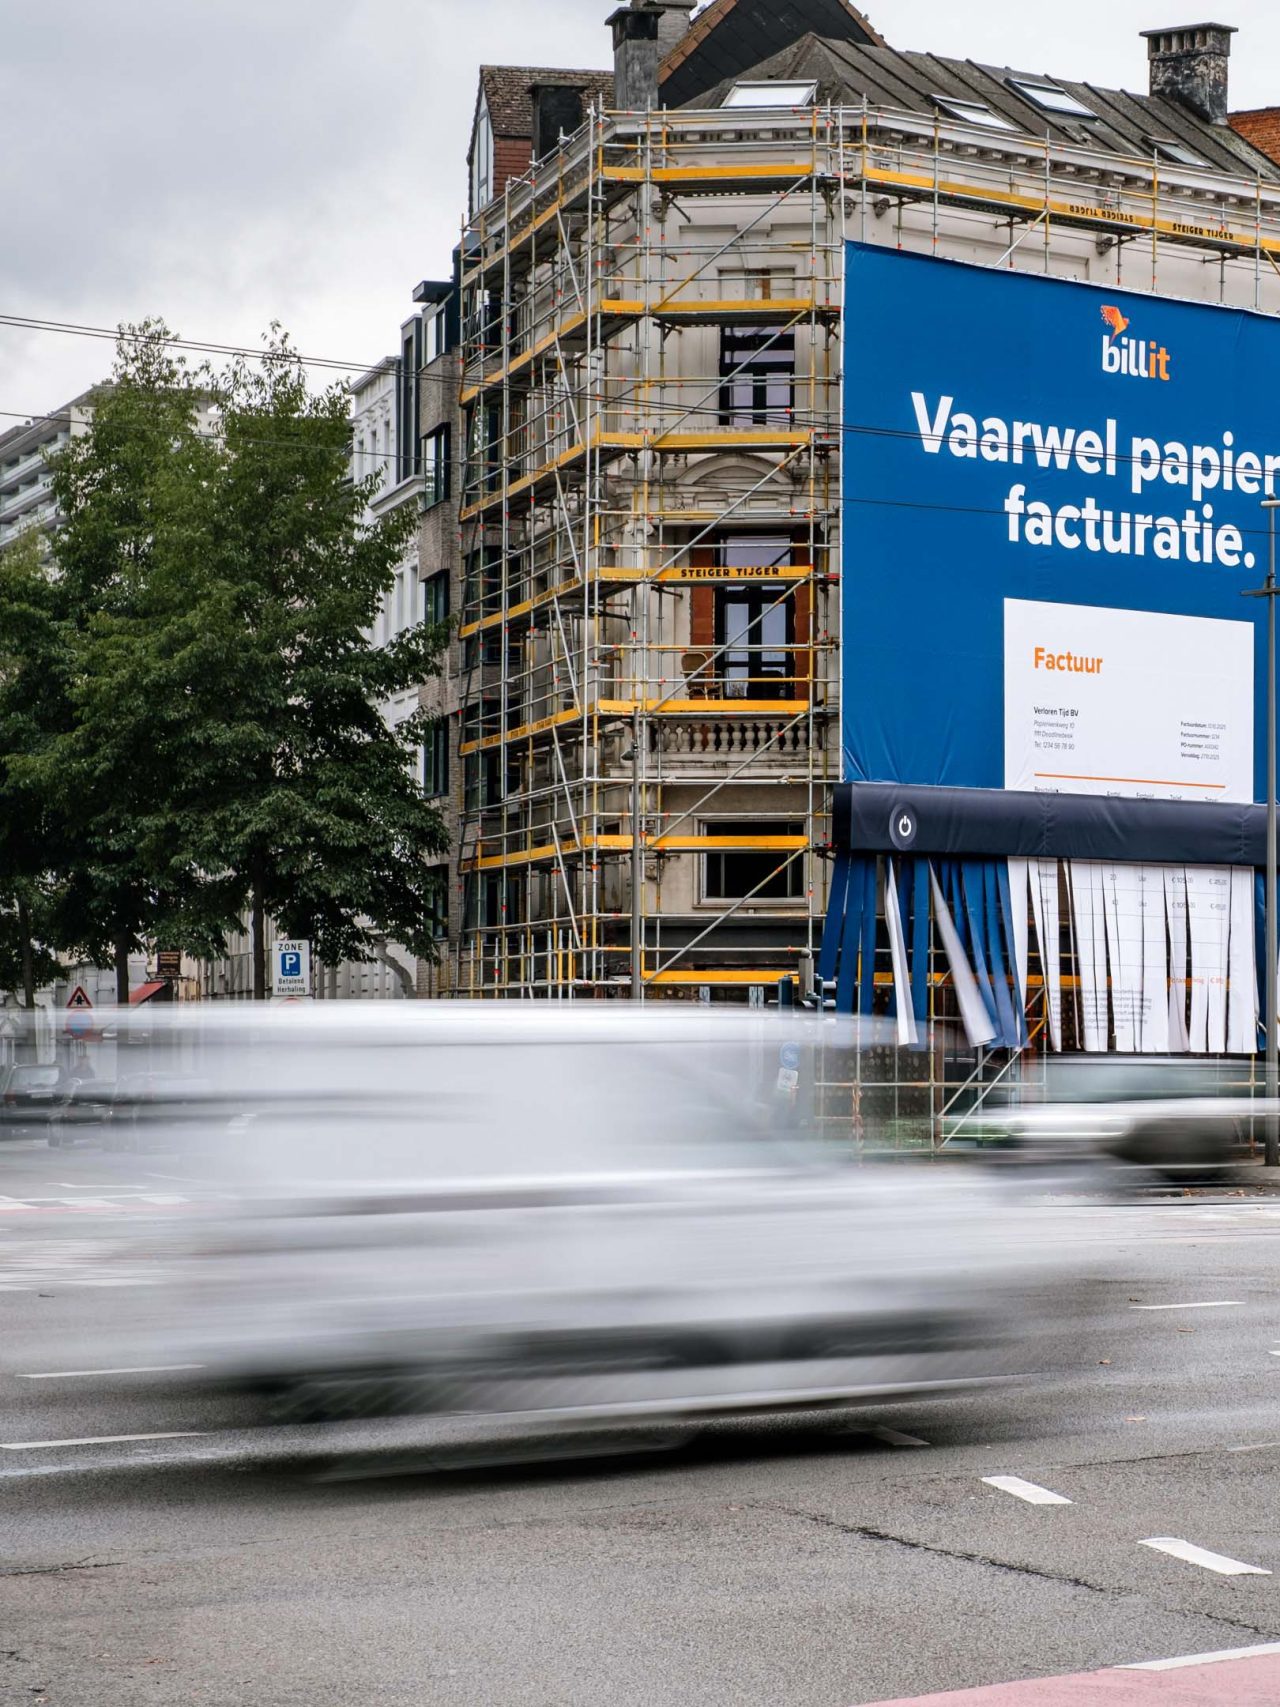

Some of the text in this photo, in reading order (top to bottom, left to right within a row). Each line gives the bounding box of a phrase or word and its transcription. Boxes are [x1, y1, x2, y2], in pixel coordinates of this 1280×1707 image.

[1173, 223, 1234, 240] STEIGER TIJGER
[1102, 335, 1170, 380] billit
[911, 392, 1116, 474] Vaarwel
[1005, 484, 1256, 568] facturatie.
[681, 568, 779, 577] STEIGER TIJGER
[1034, 647, 1103, 673] Factuur
[1034, 706, 1058, 715] Verloren
[1059, 708, 1069, 717] Tijd
[278, 943, 303, 951] ZONE
[286, 955, 296, 970] P
